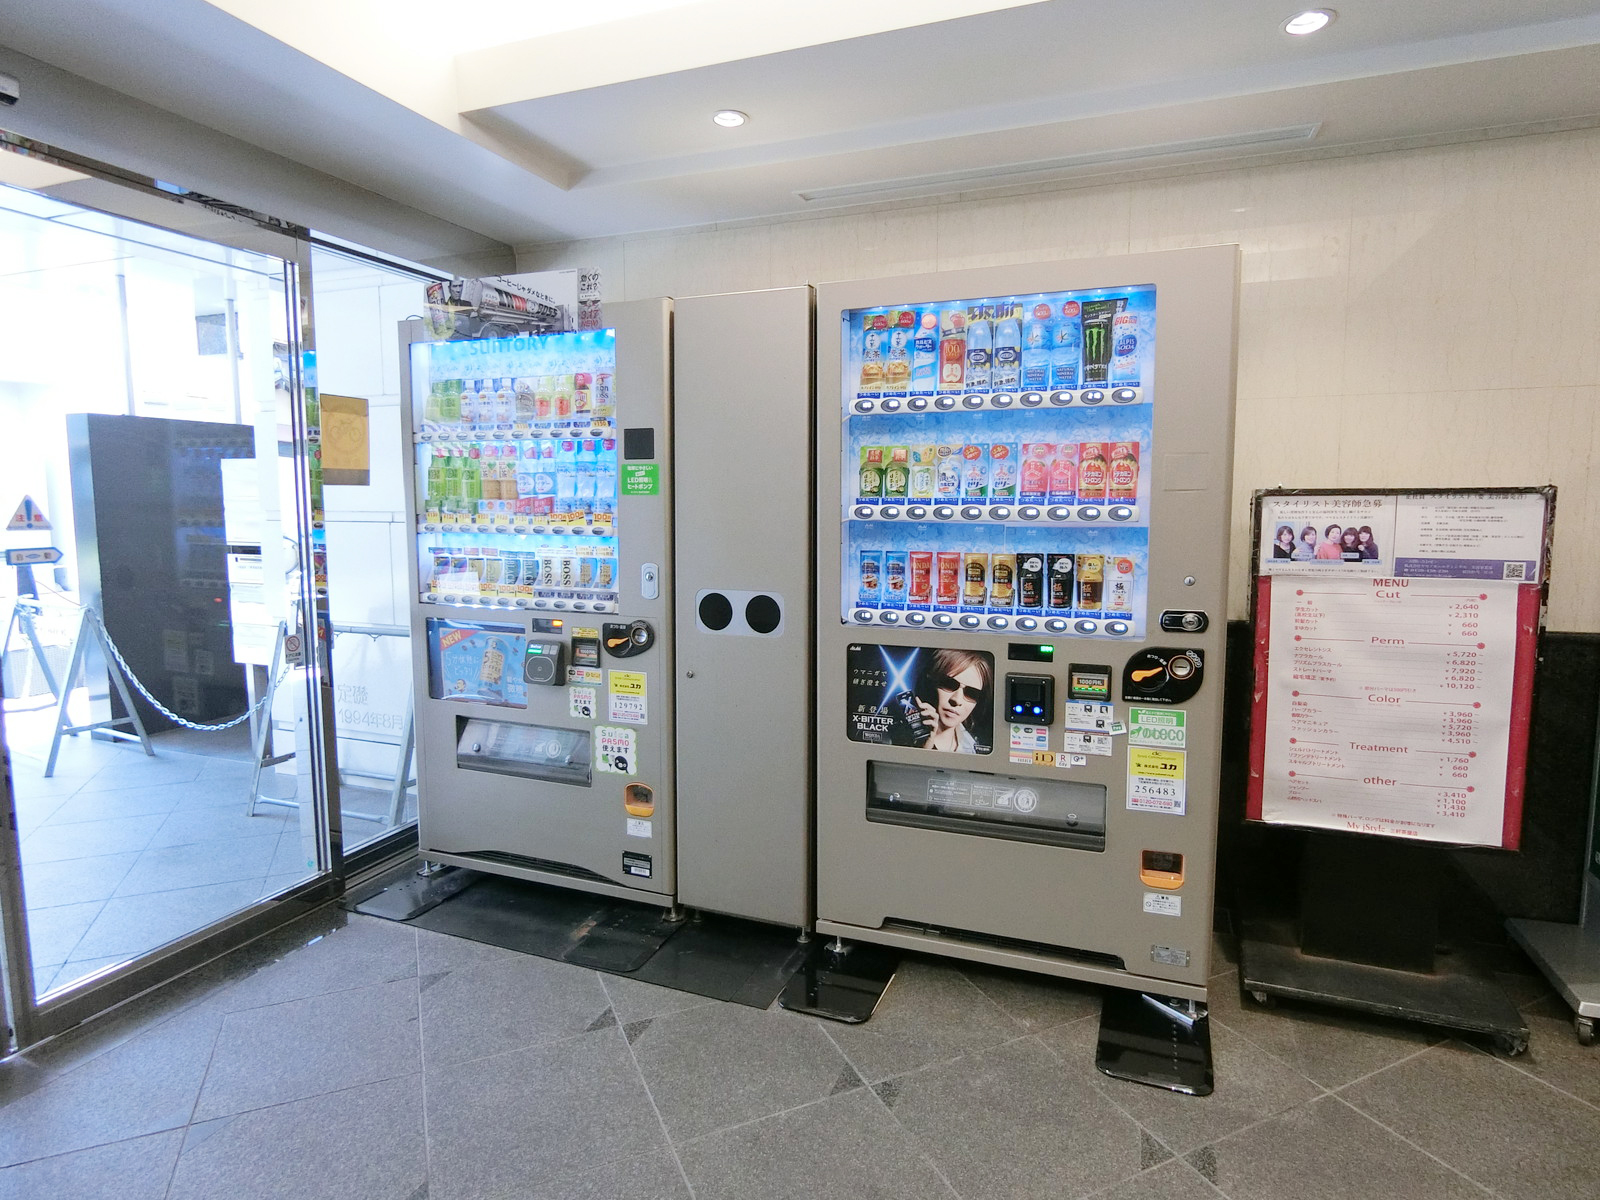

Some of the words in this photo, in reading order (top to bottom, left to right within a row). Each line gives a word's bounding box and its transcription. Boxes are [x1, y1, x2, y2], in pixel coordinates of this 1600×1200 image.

[537, 302, 558, 318] BOSS
[971, 301, 1015, 321] Asahi
[1273, 499, 1383, 509] スタイリスト美容師急募
[544, 559, 552, 585] BOSS
[562, 560, 571, 586] BOSS
[1372, 578, 1410, 588] MENU
[1375, 590, 1401, 599] Cut
[441, 630, 462, 648] NEW
[1371, 636, 1405, 645] Perm
[853, 669, 888, 677] ウマニガで
[337, 683, 369, 705] 定礎
[1368, 694, 1401, 704] Color
[614, 702, 643, 711] 129792
[857, 704, 889, 715] 新登場
[338, 708, 404, 730] 1994年8月
[852, 715, 894, 726] X-BITTER
[857, 722, 889, 732] BLACK
[601, 729, 630, 739] Suica
[601, 738, 630, 747] PASMO
[602, 745, 630, 754] 使えます
[1349, 742, 1409, 754] Treatment
[1035, 753, 1054, 762] iD
[1159, 762, 1178, 771] ユカ
[1363, 776, 1397, 786] other
[1134, 784, 1176, 797] 256483
[1346, 821, 1359, 831] My
